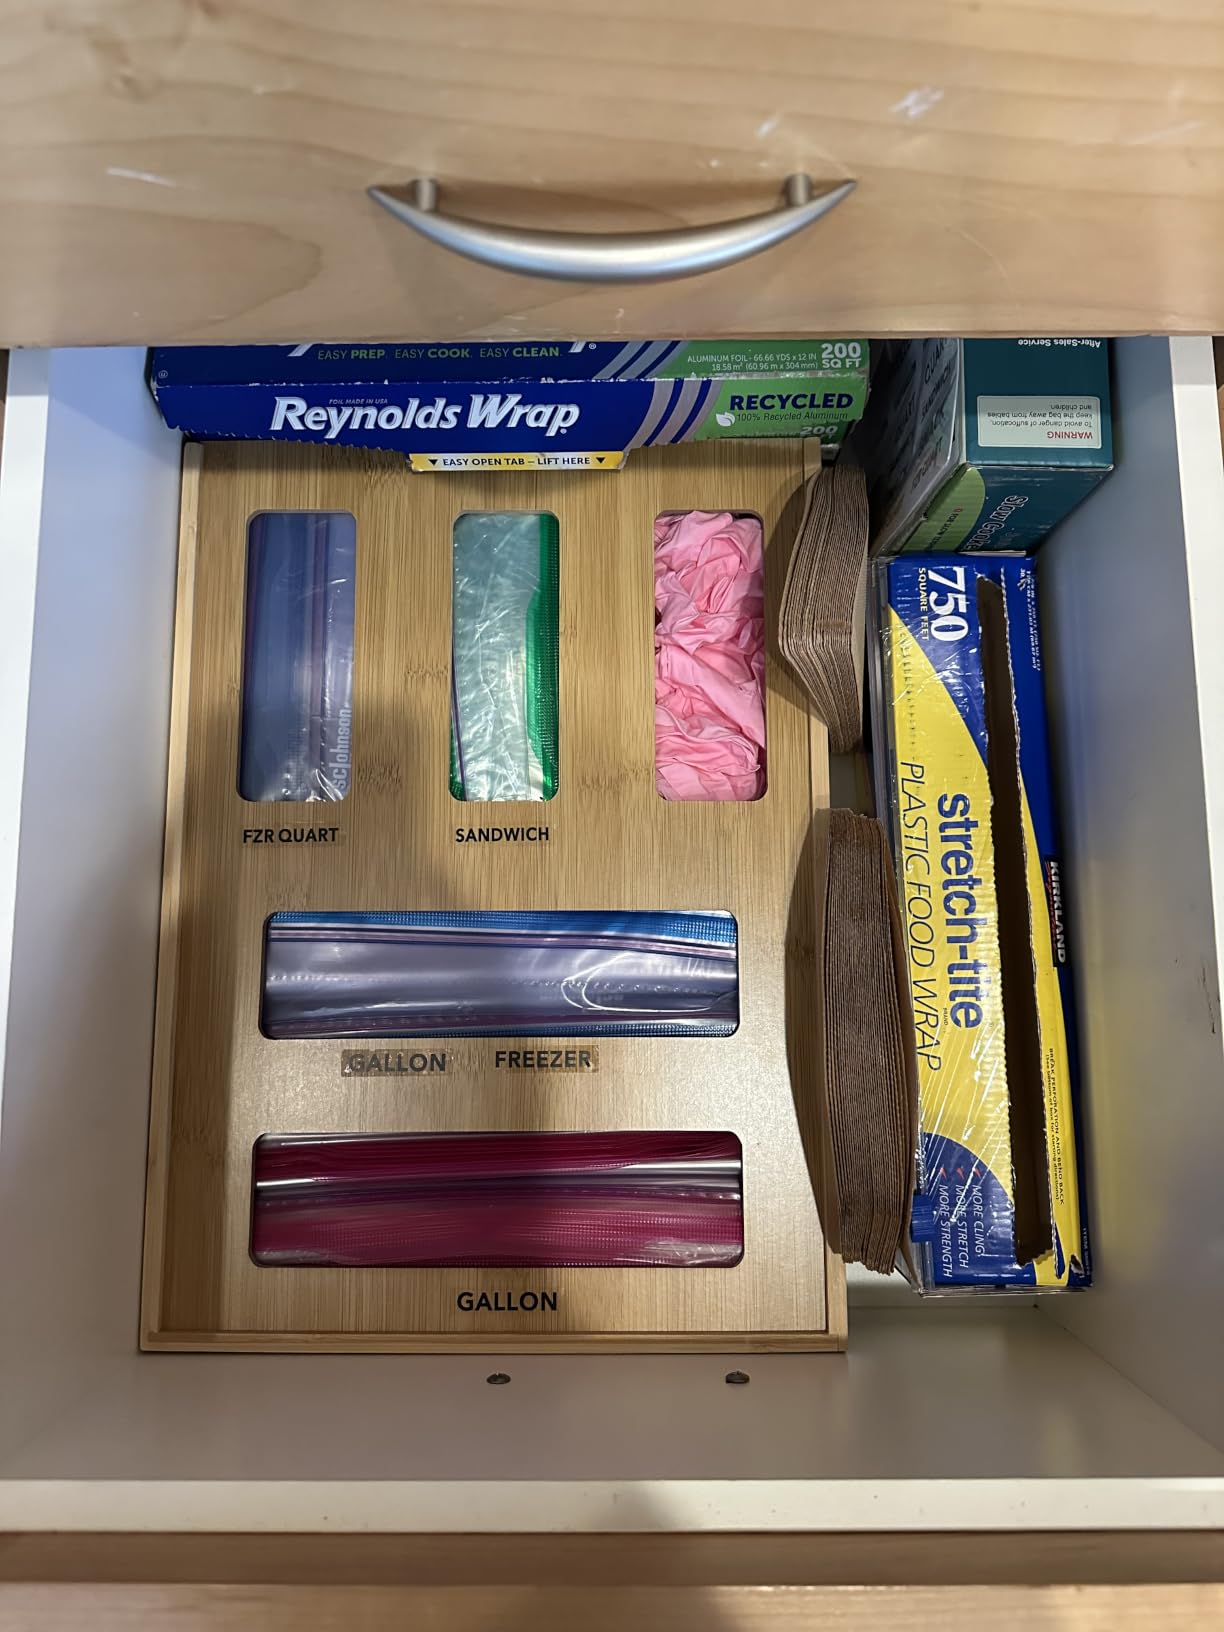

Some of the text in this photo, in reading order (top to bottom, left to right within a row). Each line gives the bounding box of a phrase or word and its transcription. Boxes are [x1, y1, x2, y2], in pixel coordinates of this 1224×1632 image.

[821, 342, 862, 359] 200
[1018, 338, 1101, 349] After-Sales Service
[317, 350, 347, 360] EASY
[395, 349, 425, 359] EASY
[479, 347, 509, 358] EASY
[687, 355, 729, 363] ALUMINUM
[753, 353, 775, 361] 66.66
[776, 353, 791, 361] YDS
[798, 353, 807, 361] 12
[711, 363, 732, 371] 18.58
[785, 361, 800, 369] 304
[821, 358, 862, 369] SQ FT
[730, 393, 854, 411] RECYCLED
[270, 393, 580, 439] Reynolds Wrap
[736, 410, 848, 421] 100% Recycled Aluminum
[1048, 411, 1062, 419] bag
[1076, 411, 1093, 419] keep
[800, 425, 838, 435] 200
[1039, 420, 1063, 428] danger
[1047, 431, 1093, 439] WARNING
[443, 457, 470, 466] EASY
[471, 457, 503, 466] OPEN
[505, 457, 526, 465] TAB
[537, 457, 560, 465] LIFT
[562, 456, 591, 465] HERE
[994, 495, 1029, 524] Slow
[918, 568, 930, 641] SQUARE FEET
[928, 565, 969, 641] 750
[243, 828, 339, 843] FZR QUART
[455, 827, 549, 842] SANDWICH
[900, 761, 942, 1071] PLASTIC FOOD WRAP
[937, 793, 991, 1028] stretch-tite
[1050, 861, 1066, 963] KIRKLAND
[348, 1051, 592, 1072] GALLON FREEZER
[1051, 1077, 1059, 1134] PERFORATION
[955, 1184, 968, 1268] MORE STRETCH
[972, 1184, 985, 1254] MORE CLING
[940, 1184, 952, 1277] MORE STRENGTH
[457, 1292, 557, 1311] GALLON
